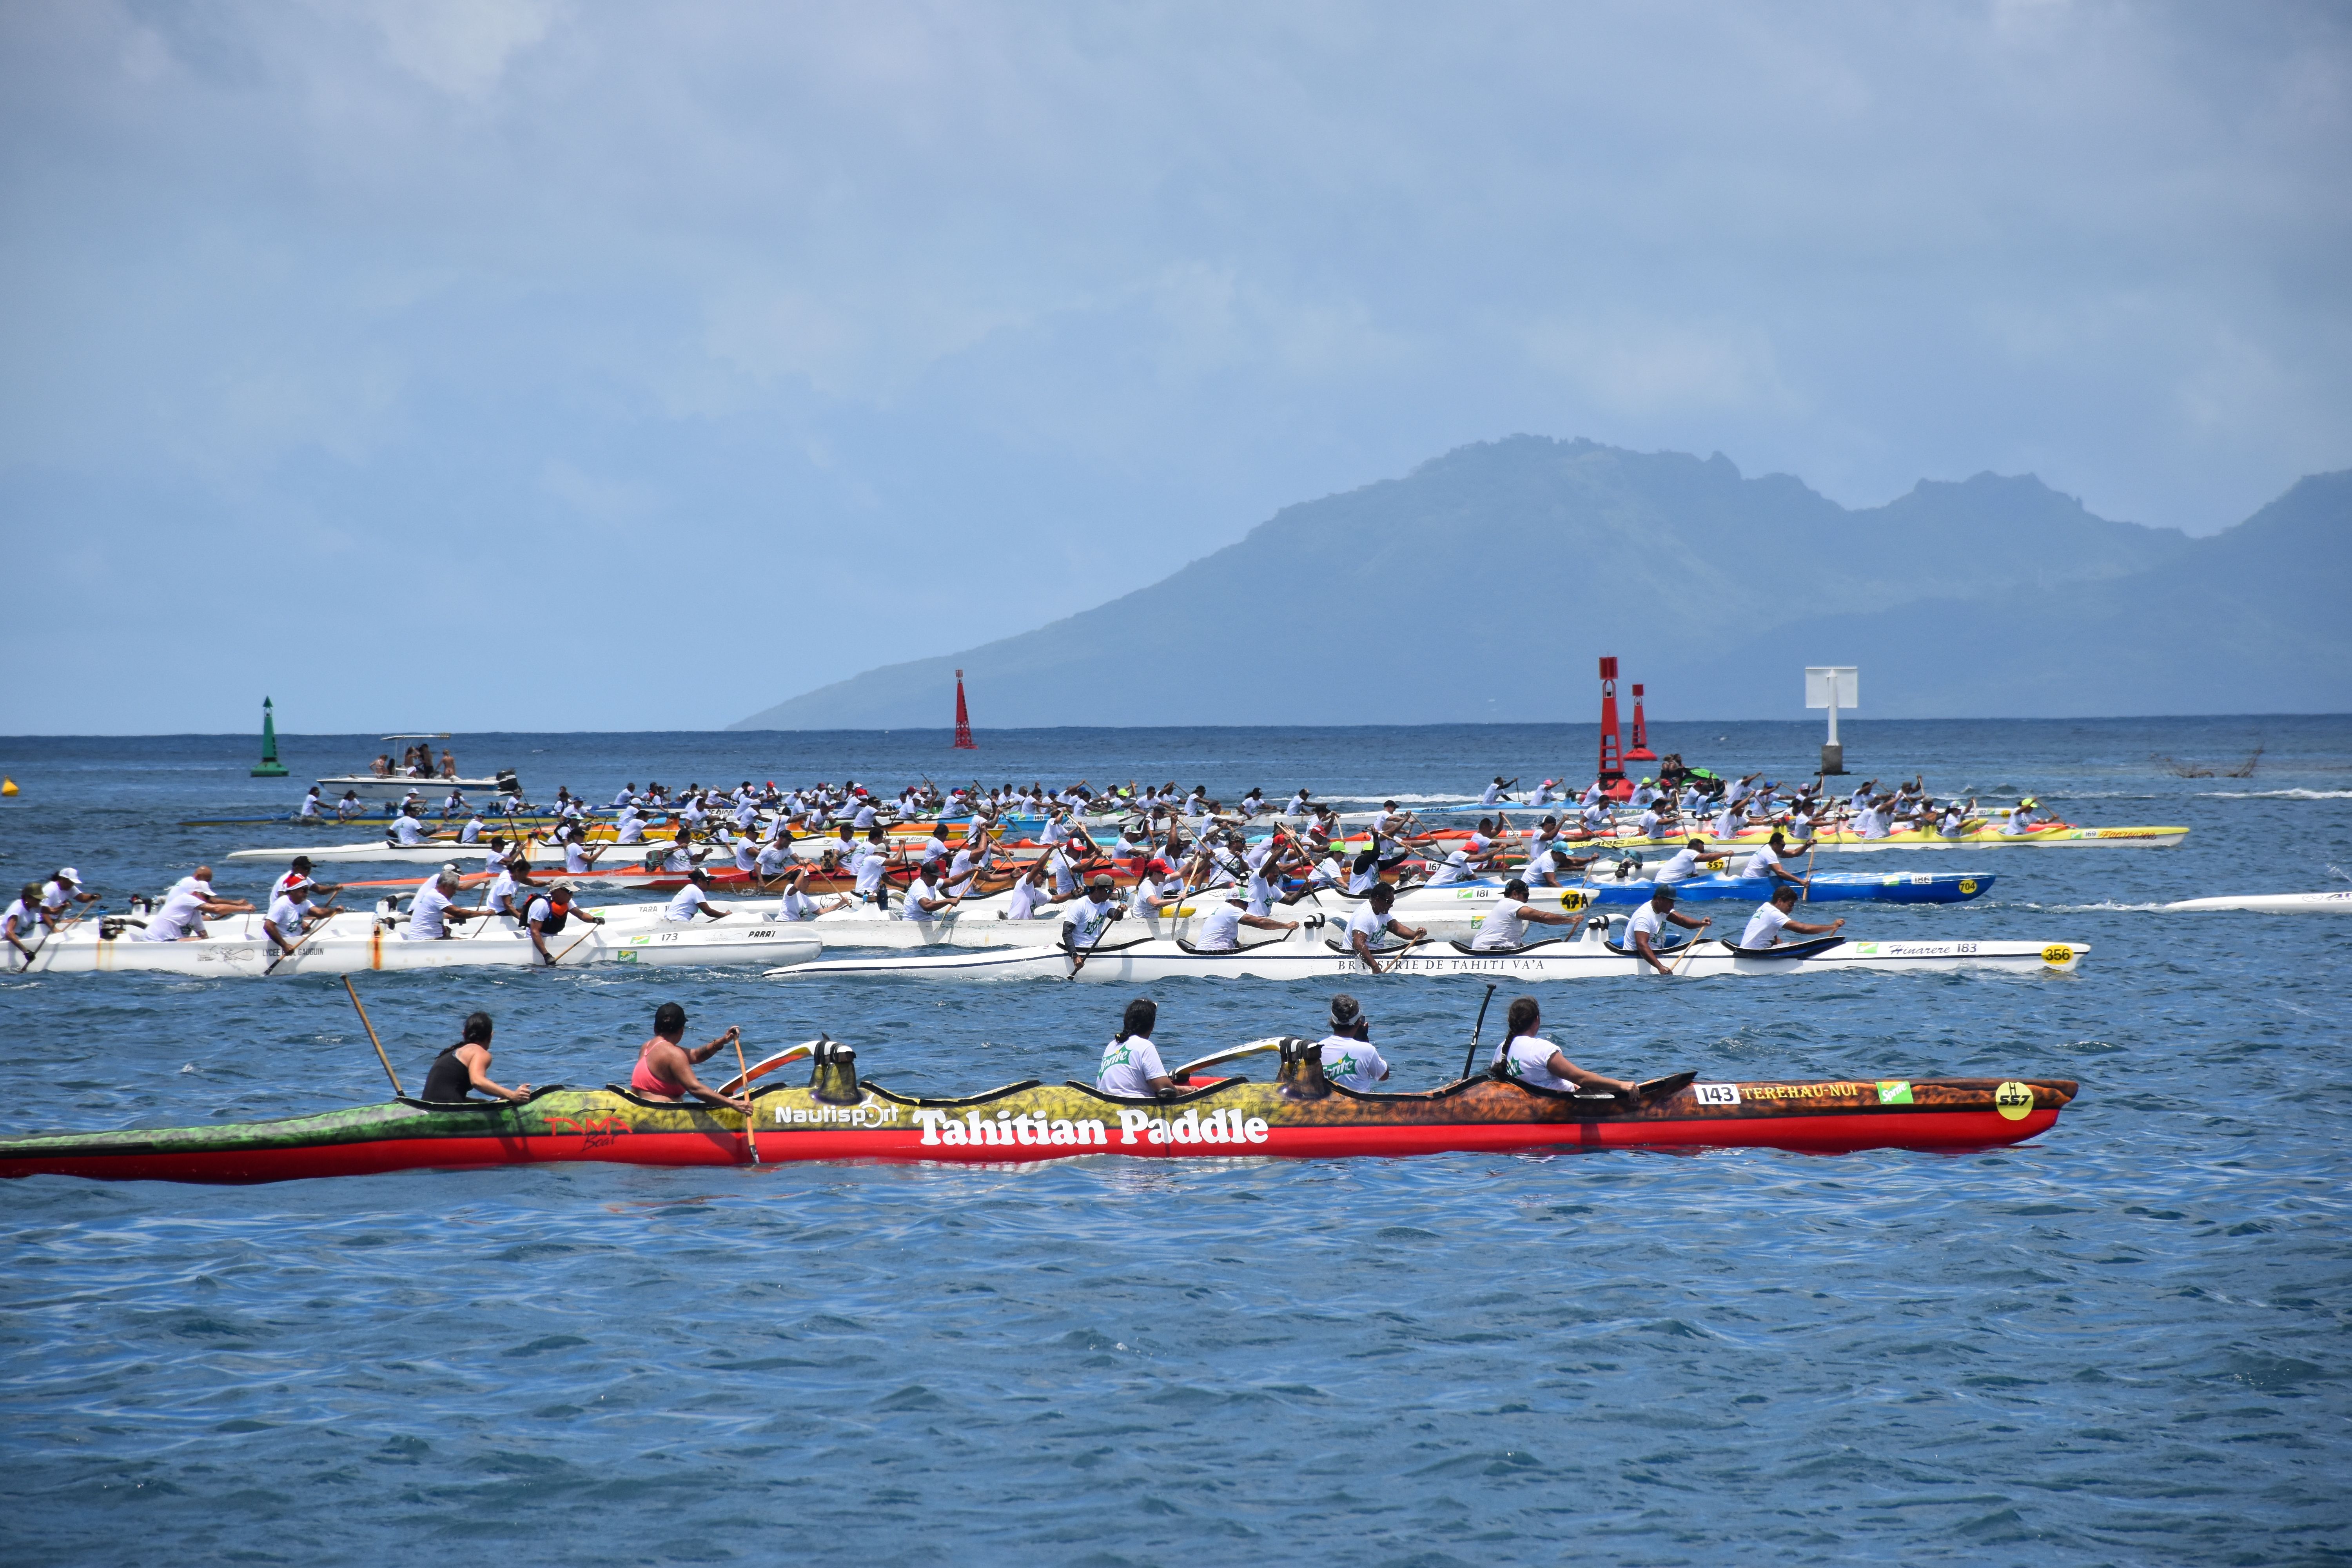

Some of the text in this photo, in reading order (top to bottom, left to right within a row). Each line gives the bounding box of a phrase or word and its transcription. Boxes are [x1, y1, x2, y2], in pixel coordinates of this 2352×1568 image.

[1914, 875, 1930, 884] 186
[1960, 882, 1975, 891] 704
[661, 933, 678, 941] 173
[1889, 944, 1951, 955] Hinarere
[1957, 943, 1977, 953] 183
[2045, 948, 2070, 961] 356
[1425, 960, 1443, 970] DE
[1451, 959, 1505, 970] TAHITI
[1701, 1087, 1735, 1102] 143
[1882, 1082, 1907, 1103] Sprite
[1998, 1095, 2031, 1106] 557
[912, 1108, 1269, 1146] Tahitian Paddle
